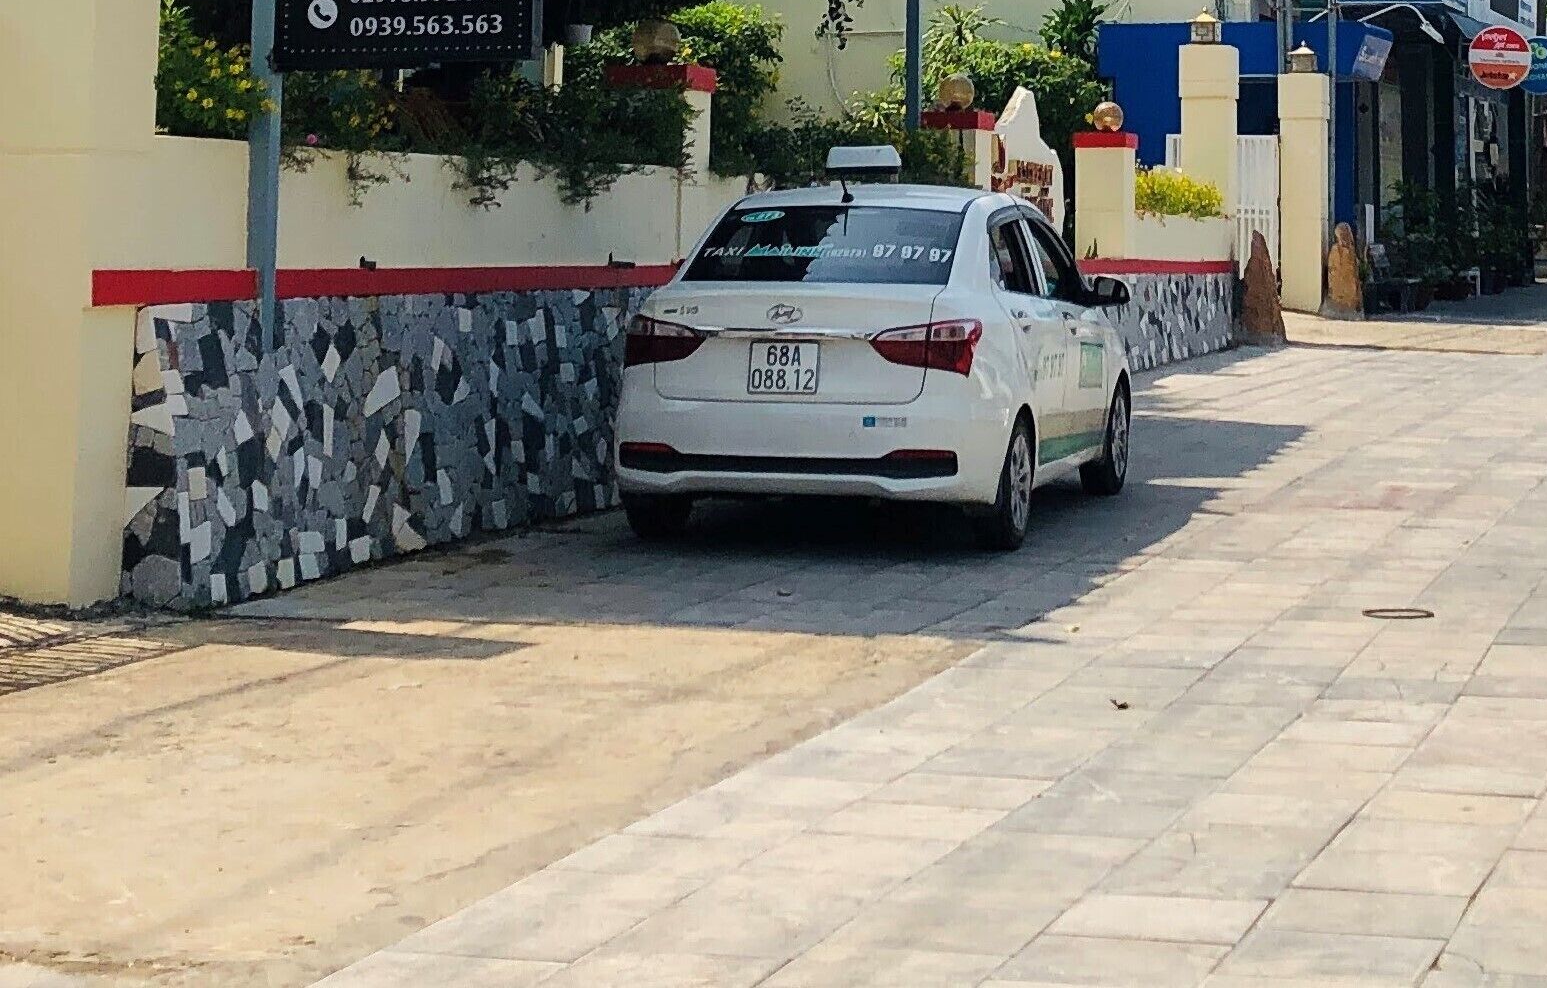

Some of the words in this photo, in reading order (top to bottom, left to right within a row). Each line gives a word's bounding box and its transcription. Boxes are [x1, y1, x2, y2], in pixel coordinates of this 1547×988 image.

[349, 14, 503, 36] 0939.563.563
[703, 246, 743, 258] TAXI
[767, 345, 801, 367] 68A
[751, 368, 815, 391] 088.12
